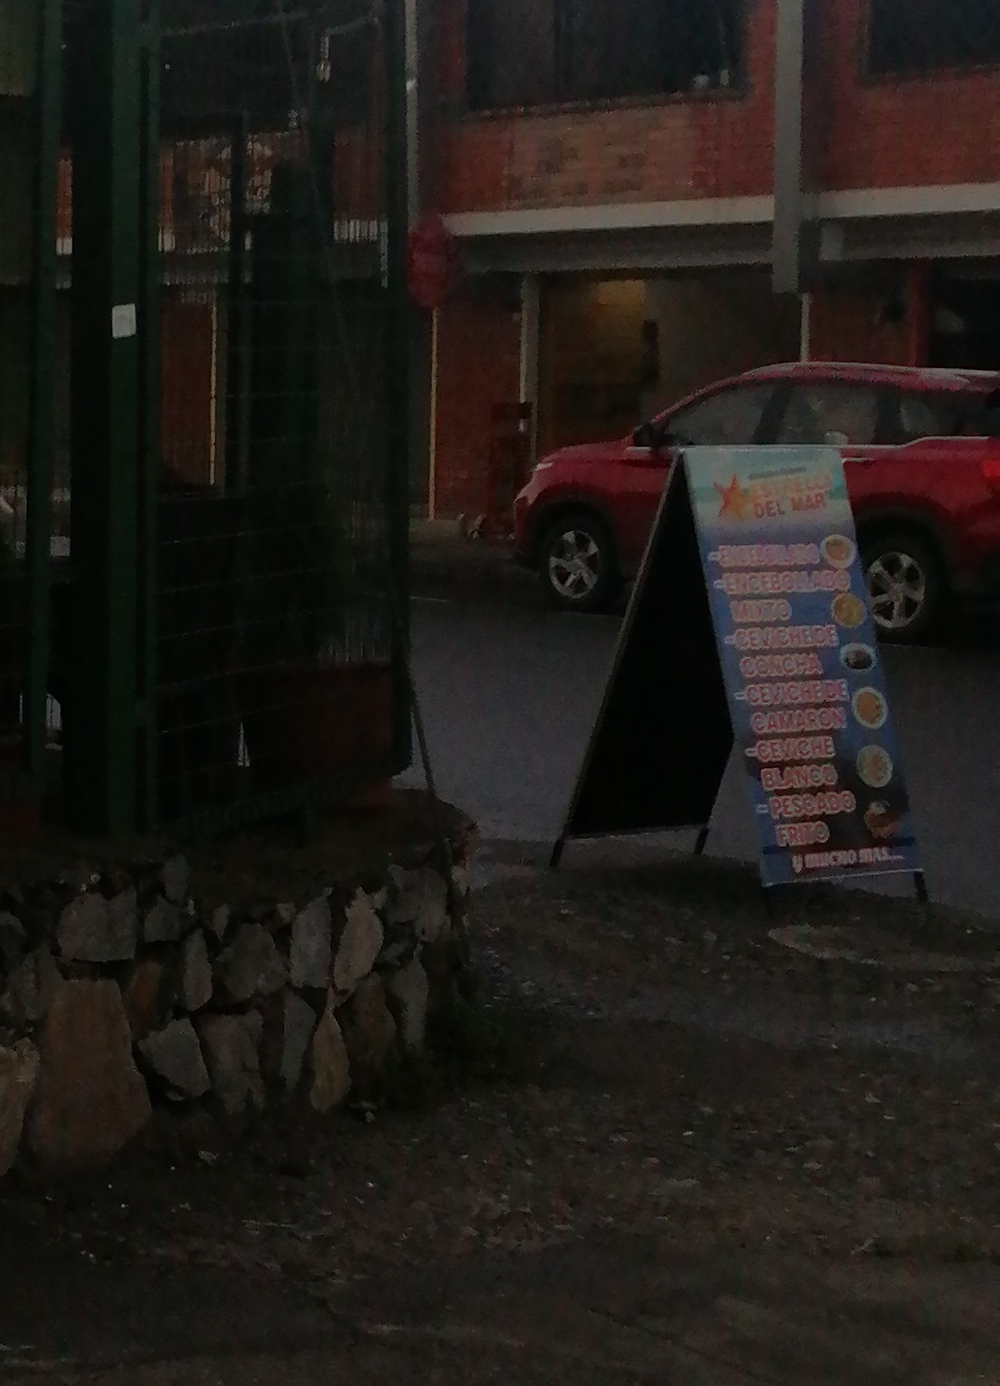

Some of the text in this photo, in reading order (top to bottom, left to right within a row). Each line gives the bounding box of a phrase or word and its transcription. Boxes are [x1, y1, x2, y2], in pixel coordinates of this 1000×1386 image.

[753, 491, 828, 519] DEL MAR
[760, 763, 839, 792] BLANCO
[775, 820, 831, 847] FRITO
